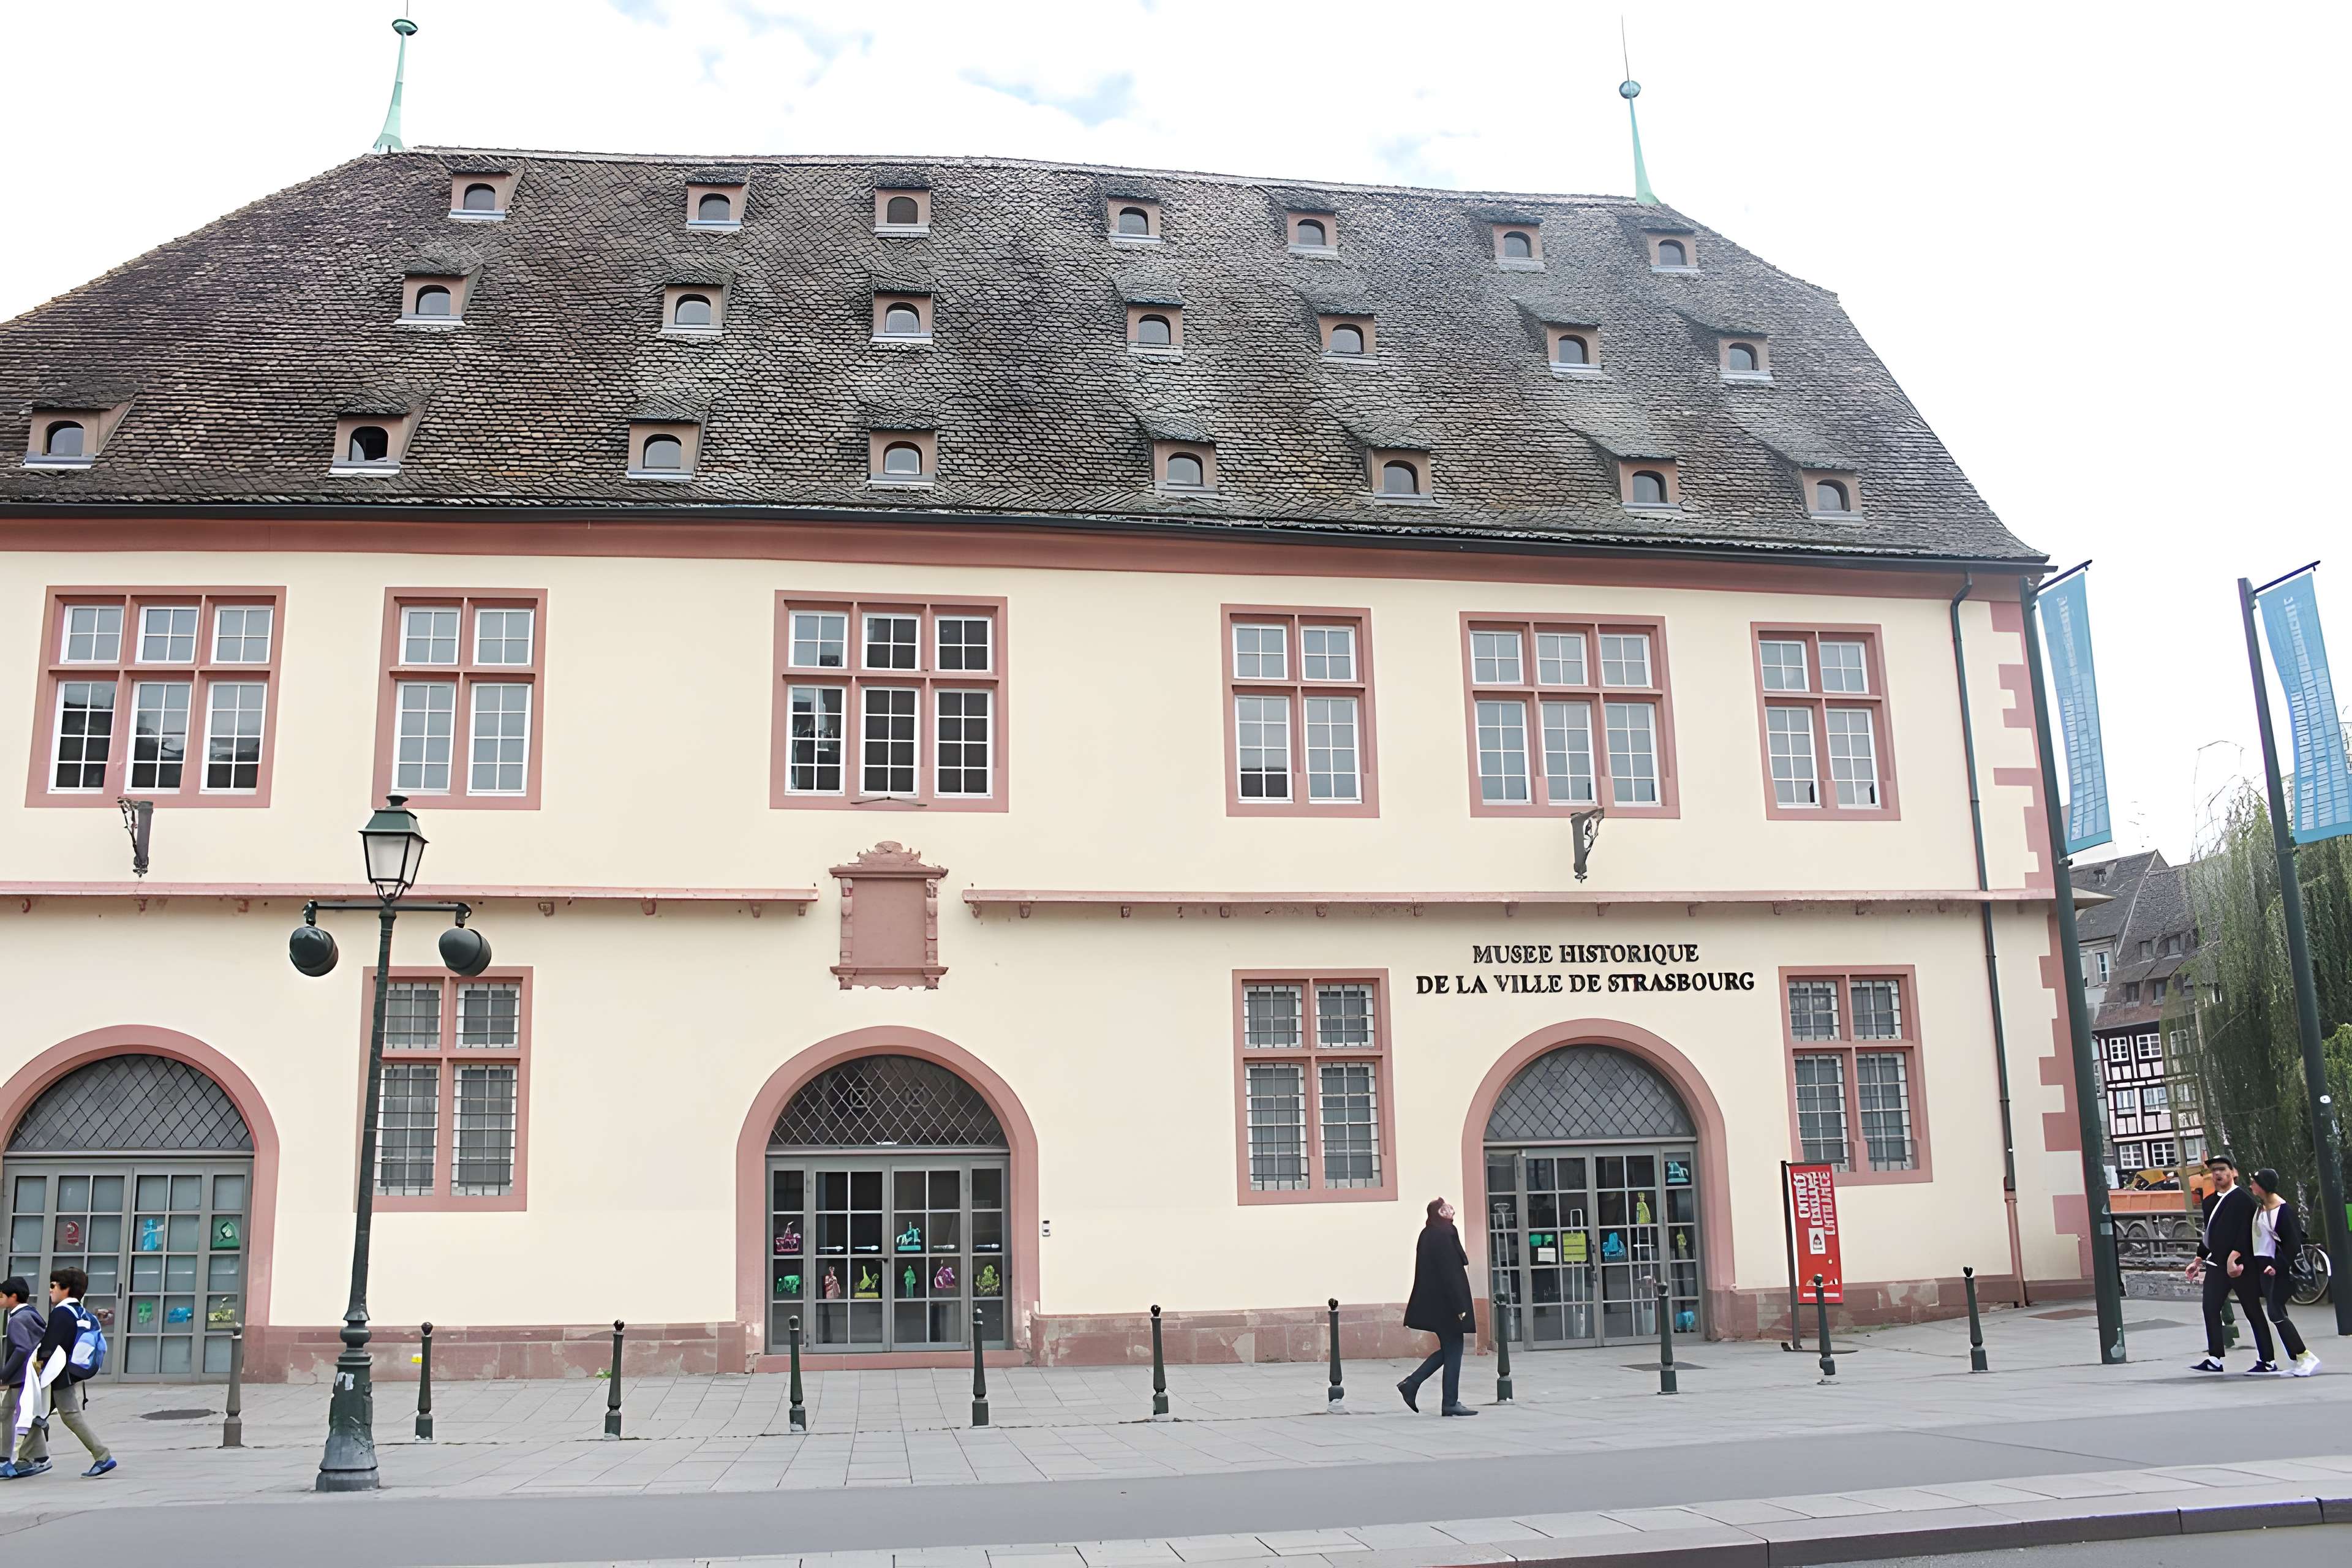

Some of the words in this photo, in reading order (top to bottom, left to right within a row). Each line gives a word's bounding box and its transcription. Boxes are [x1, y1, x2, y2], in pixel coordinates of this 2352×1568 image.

[1472, 944, 1553, 963] MUSEE
[1559, 944, 1699, 965] HISTORIQUE
[1415, 974, 1449, 993] DE
[1455, 974, 1487, 993] LA
[1493, 974, 1563, 993] VILLE
[1568, 974, 1602, 992] DE
[1608, 972, 1754, 992] STRASBOURG
